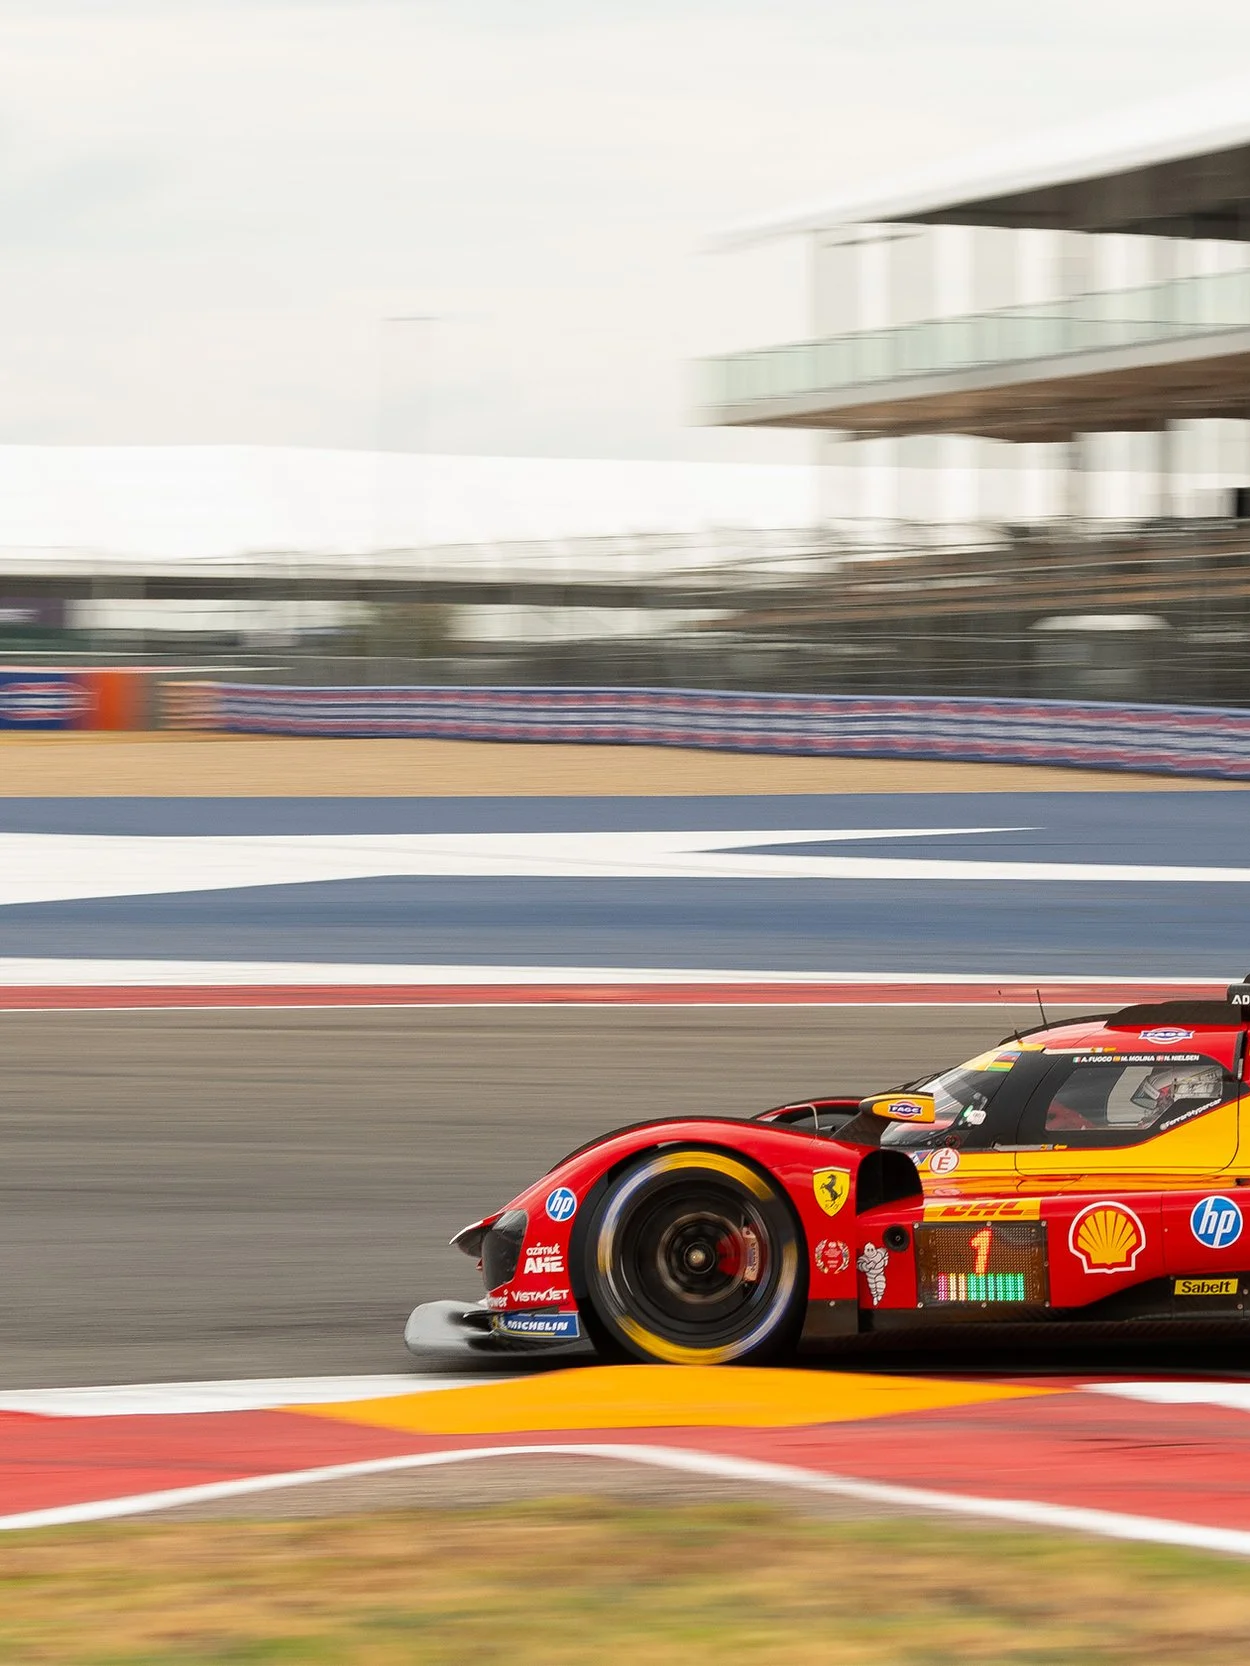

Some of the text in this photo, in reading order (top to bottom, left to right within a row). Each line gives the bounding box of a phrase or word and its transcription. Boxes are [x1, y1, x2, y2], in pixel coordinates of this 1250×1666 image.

[937, 1156, 950, 1171] E
[549, 1188, 574, 1220] hp
[1198, 1197, 1237, 1247] hp
[968, 1227, 993, 1276] 1
[1181, 1280, 1232, 1294] Sabelt
[506, 1319, 569, 1332] MICHELIN
